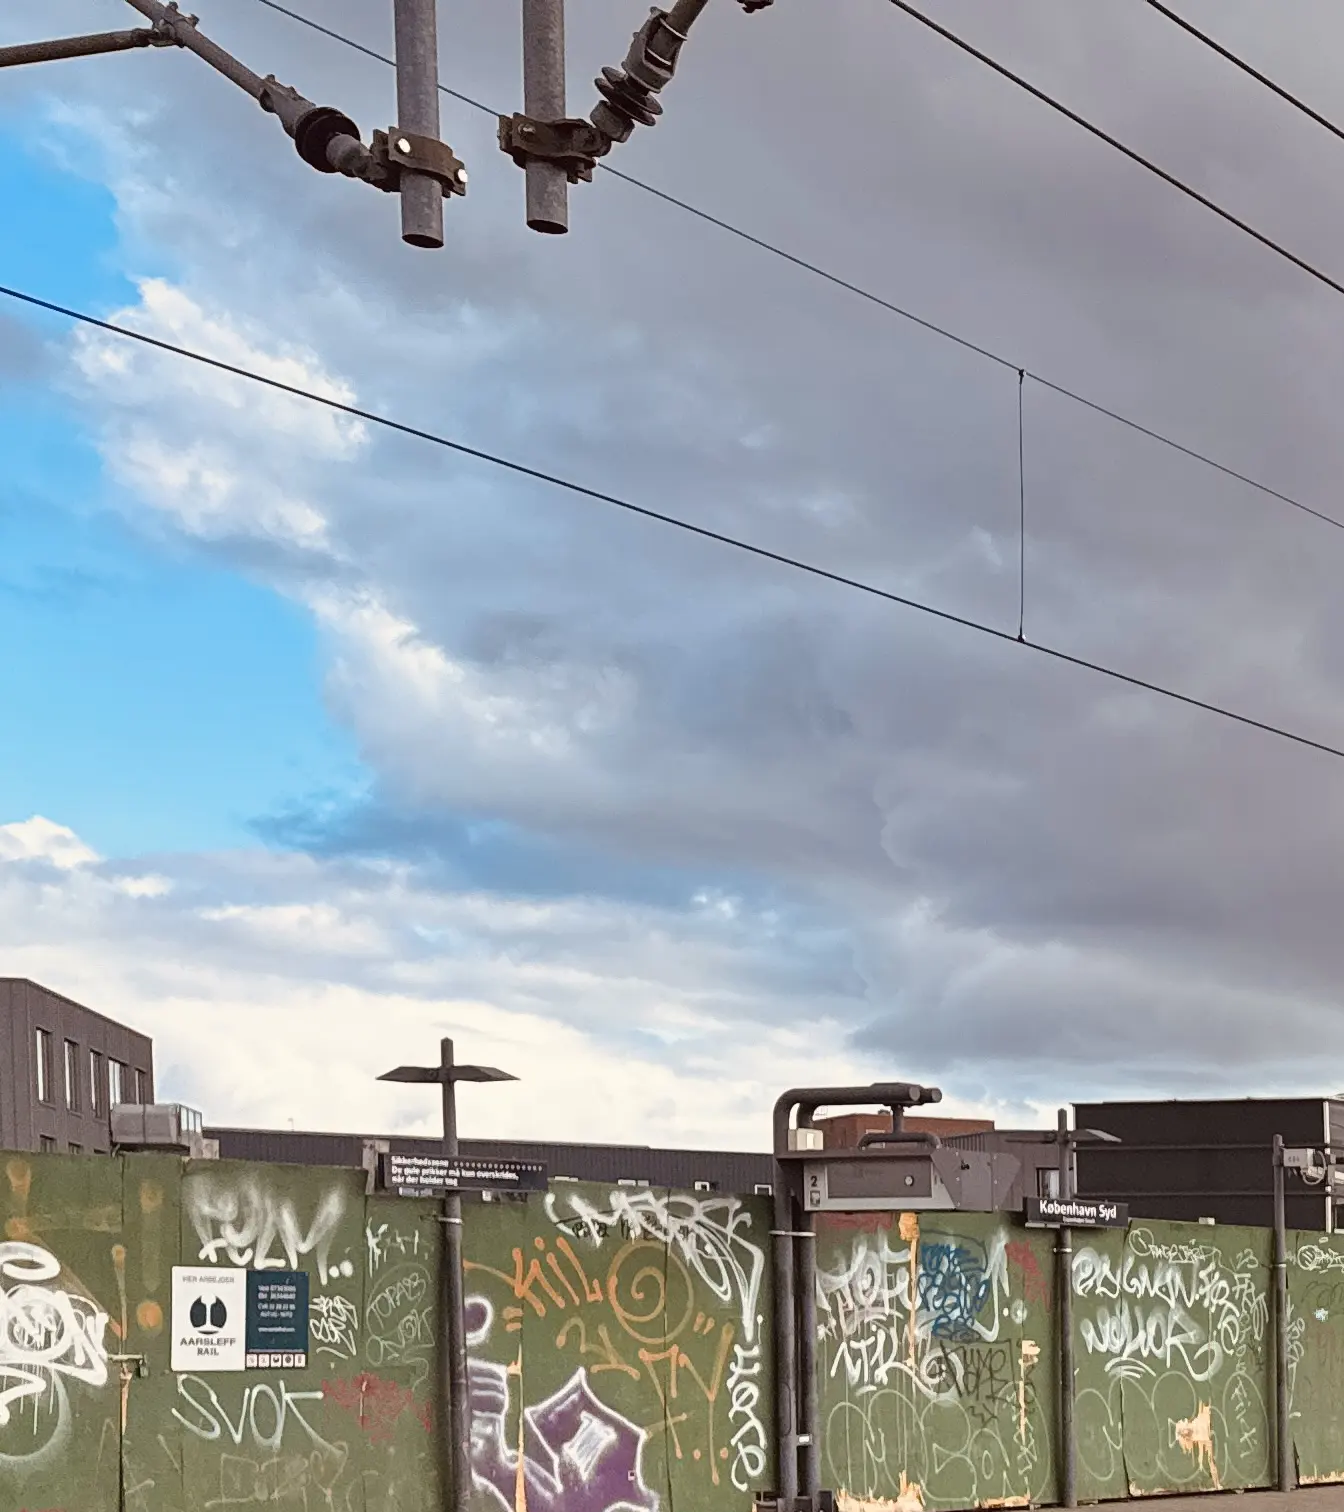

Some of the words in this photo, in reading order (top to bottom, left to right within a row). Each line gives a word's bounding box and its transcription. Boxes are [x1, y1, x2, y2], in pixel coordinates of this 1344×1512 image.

[810, 1175, 818, 1187] 2
[1039, 1199, 1097, 1218] København
[1098, 1204, 1117, 1221] Syd
[180, 1337, 236, 1347] AARSLEFF
[196, 1347, 219, 1356] RAIL
